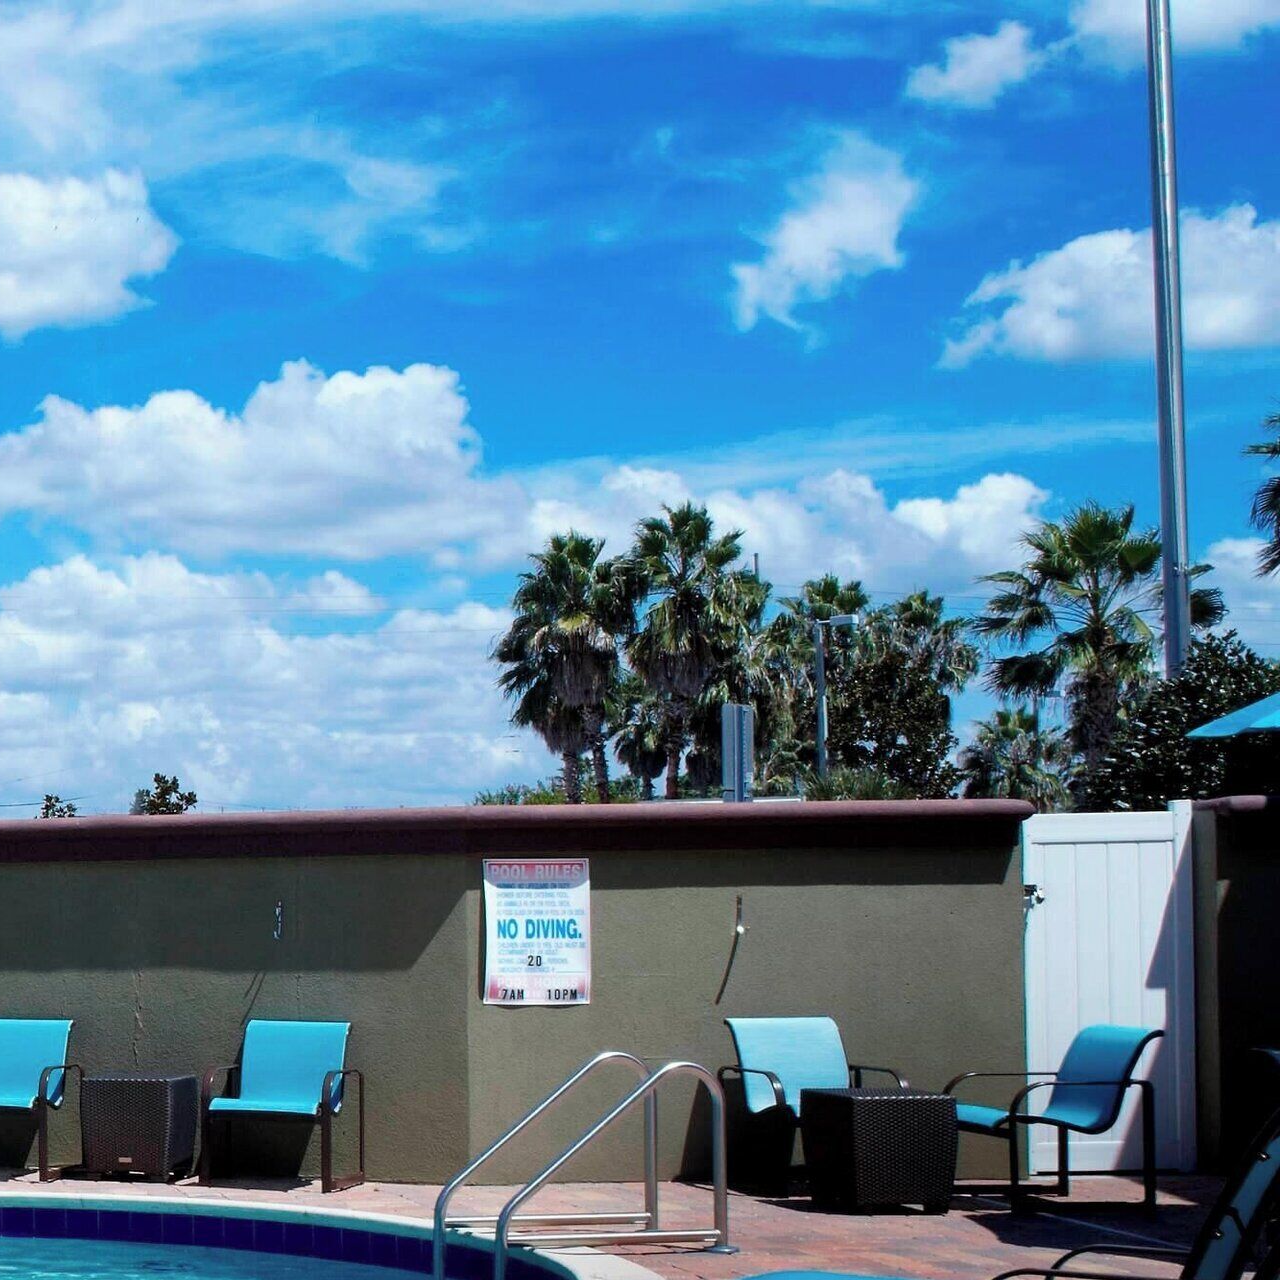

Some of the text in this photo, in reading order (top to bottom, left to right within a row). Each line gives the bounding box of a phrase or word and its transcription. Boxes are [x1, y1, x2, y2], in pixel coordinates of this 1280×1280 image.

[491, 865, 580, 879] POOL RULES
[497, 919, 582, 939] NO DIVING.
[528, 955, 542, 967] 20
[502, 989, 578, 1000] 7AM 10PM
